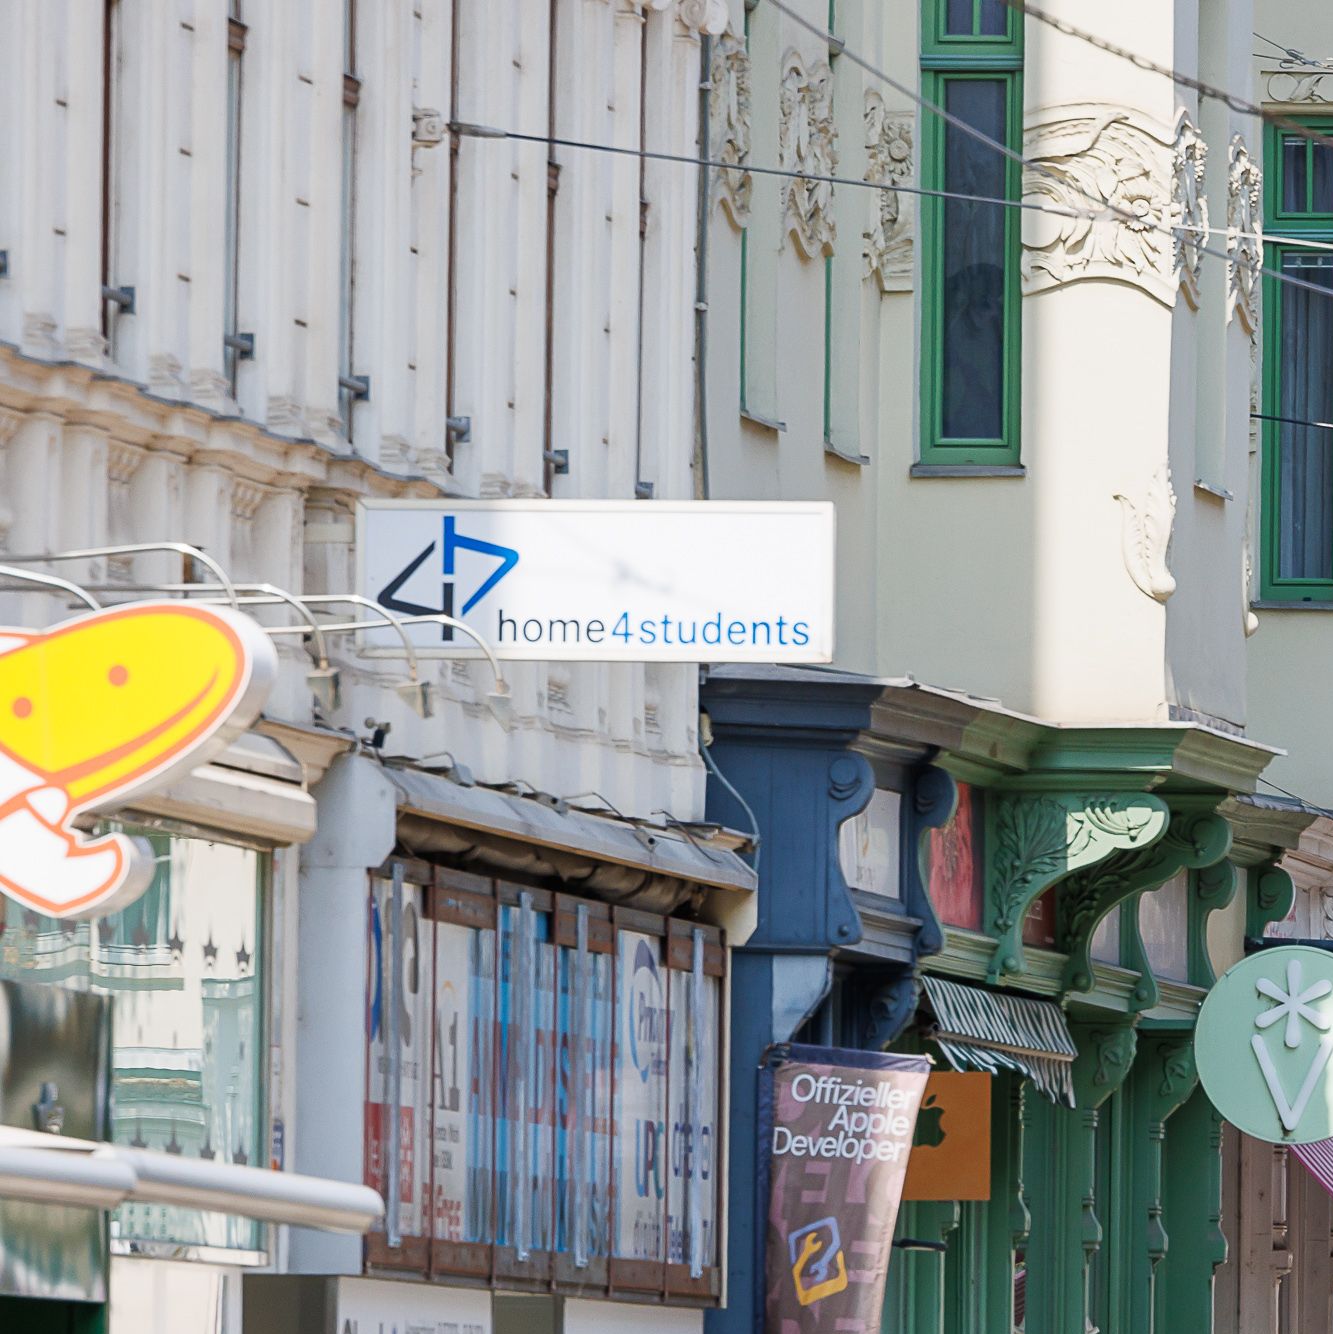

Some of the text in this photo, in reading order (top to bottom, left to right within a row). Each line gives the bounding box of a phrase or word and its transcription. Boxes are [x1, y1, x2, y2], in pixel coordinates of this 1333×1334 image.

[499, 609, 810, 645] home4students
[791, 1073, 917, 1110] Offizieller
[828, 1105, 910, 1138] Apple
[772, 1126, 907, 1165] Developer
